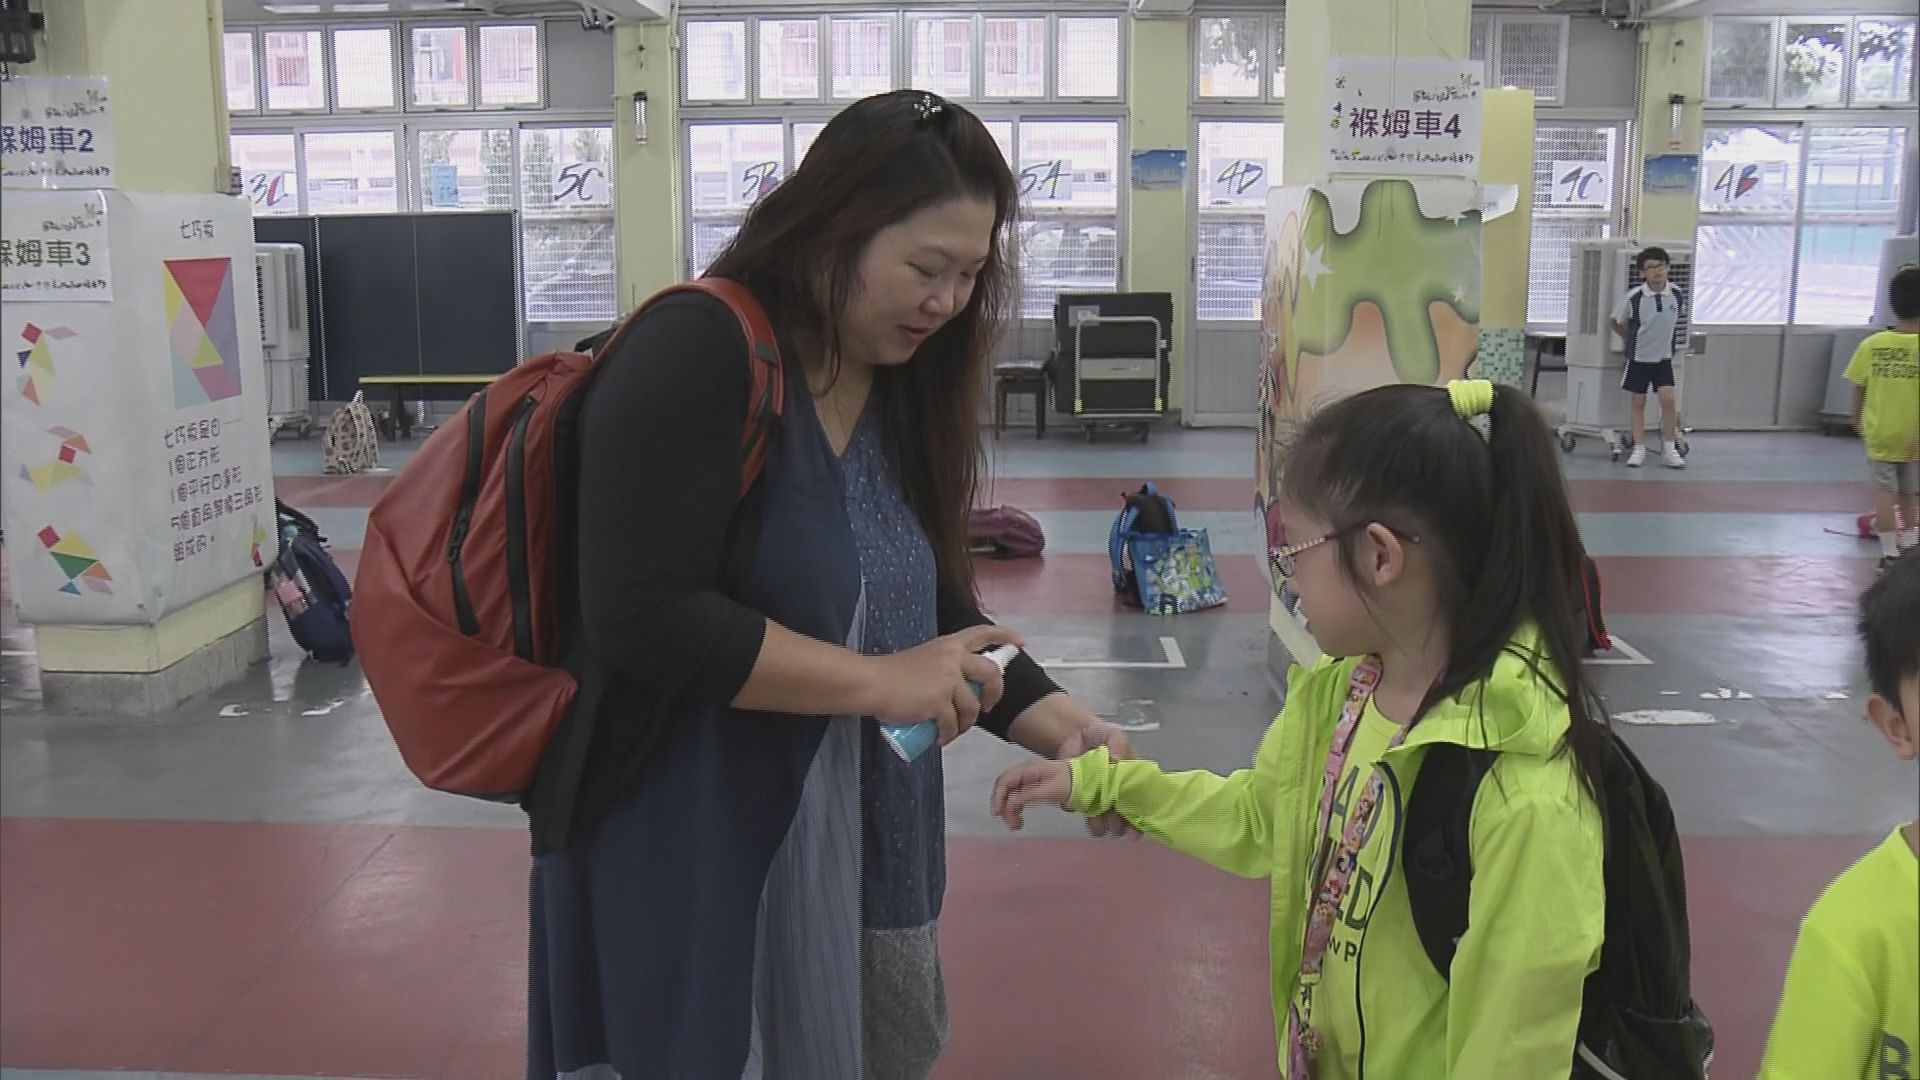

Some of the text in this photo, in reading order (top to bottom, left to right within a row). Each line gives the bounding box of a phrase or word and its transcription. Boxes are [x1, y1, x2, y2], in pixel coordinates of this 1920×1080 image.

[1349, 108, 1462, 139] 褓姆車4
[247, 171, 295, 206] 3C
[554, 163, 604, 202] 5C
[1019, 159, 1072, 199] 5A
[1217, 159, 1264, 195] 4D
[1559, 165, 1604, 202] 4C
[1713, 163, 1761, 203] 4B
